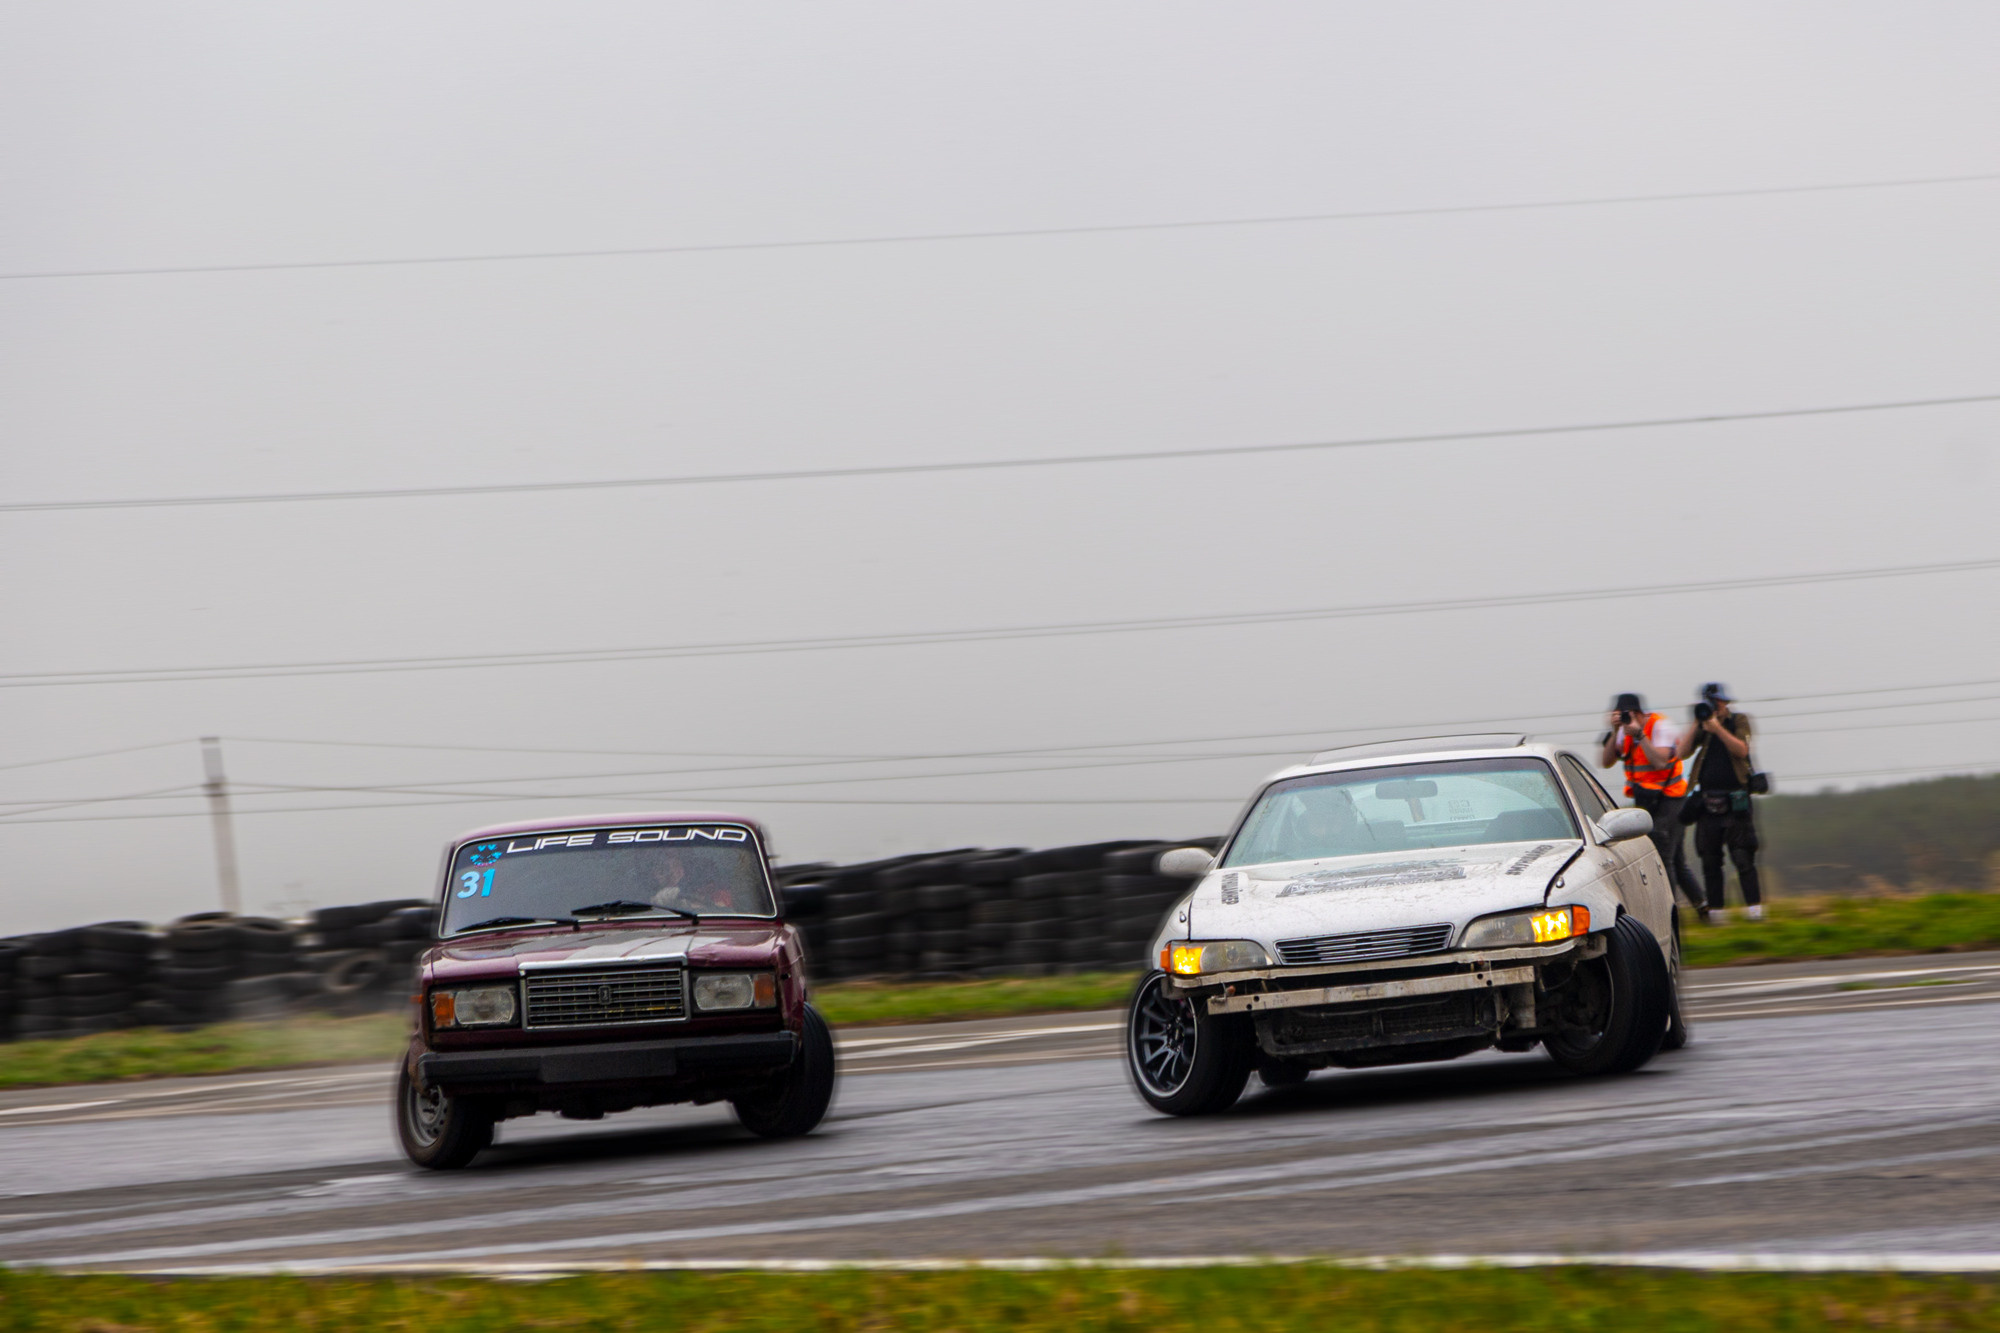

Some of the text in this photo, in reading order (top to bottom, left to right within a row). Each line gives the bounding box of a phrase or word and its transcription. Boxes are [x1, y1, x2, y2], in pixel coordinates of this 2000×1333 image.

[506, 828, 748, 853] LIFE SOUND
[457, 868, 496, 899] 31
